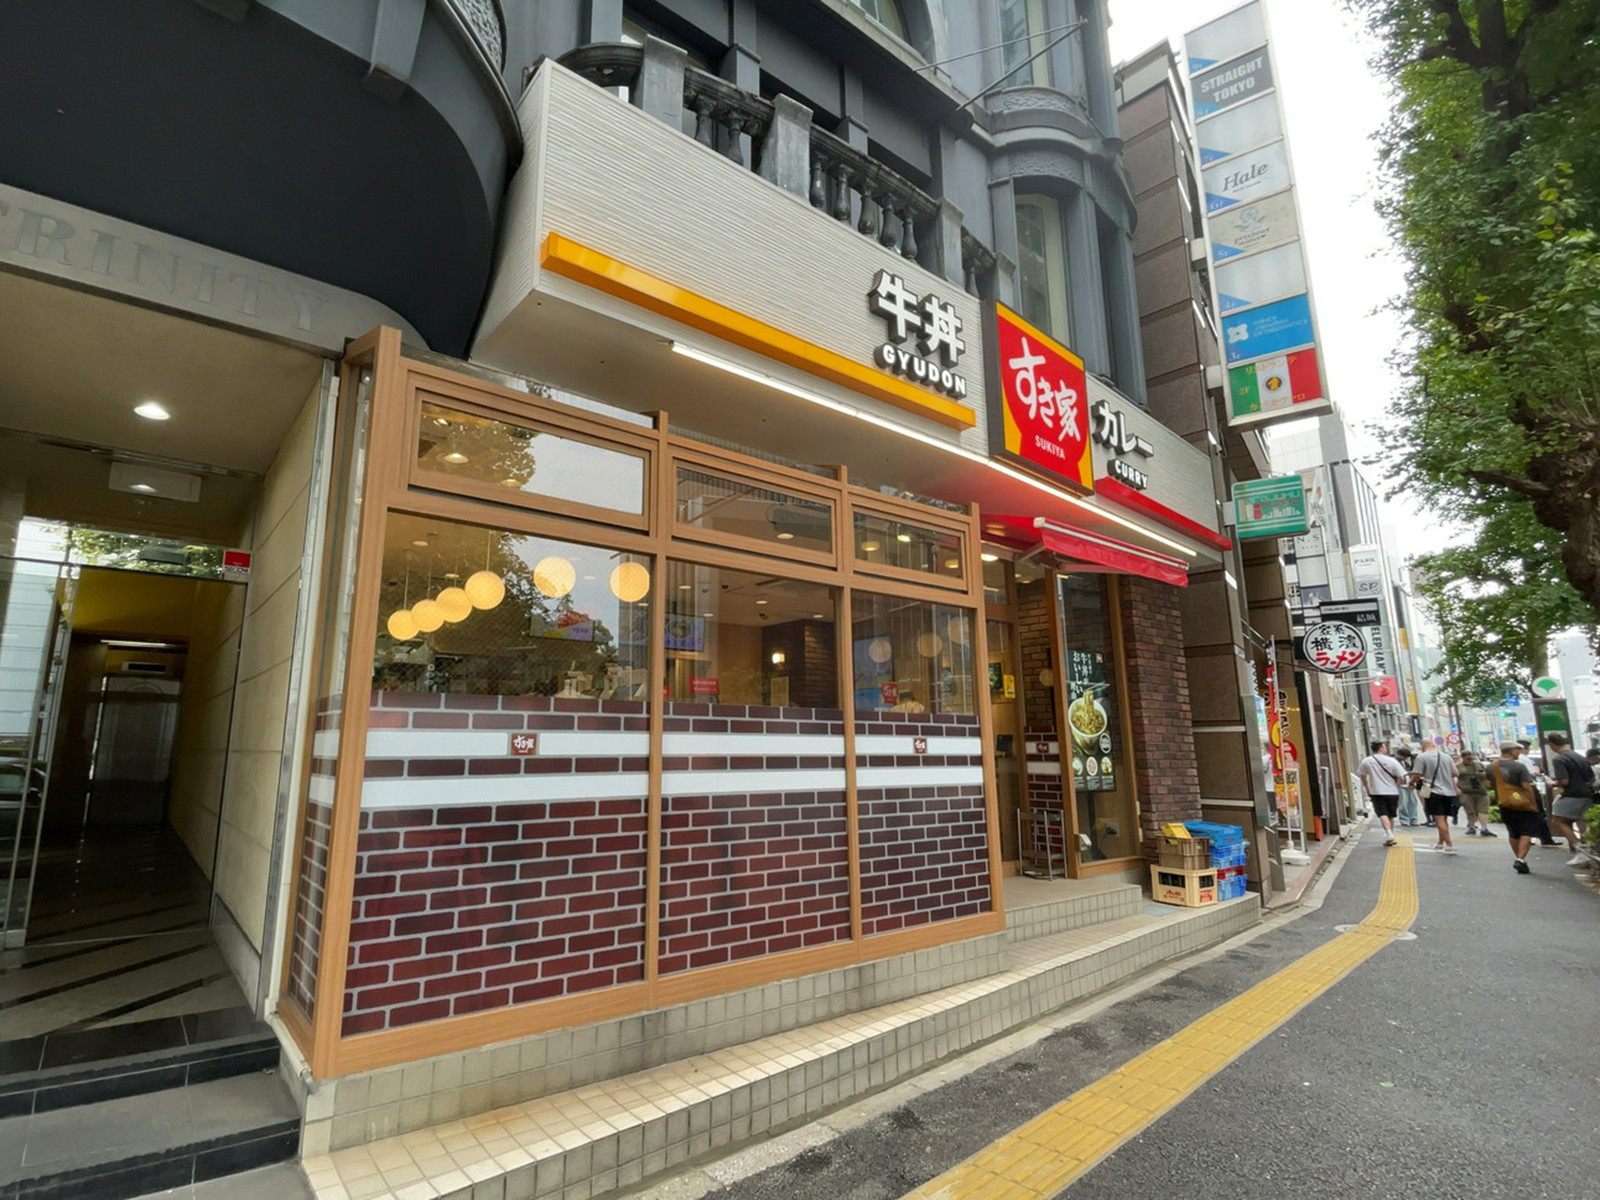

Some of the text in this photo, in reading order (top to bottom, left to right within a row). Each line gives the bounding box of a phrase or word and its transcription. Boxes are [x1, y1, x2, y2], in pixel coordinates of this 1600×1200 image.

[1200, 56, 1264, 93] STRAIGHT
[1212, 77, 1256, 103] TOKYO
[1222, 163, 1269, 193] Hale
[0, 203, 327, 334] RINITY
[874, 270, 965, 364] 牛丼
[881, 344, 967, 398] GYUDON
[1008, 336, 1081, 442] すき家
[1034, 434, 1066, 461] SUKIYA
[1097, 401, 1154, 456] カレー
[1113, 459, 1148, 489] CURRY
[1072, 650, 1084, 695] おいしい
[1314, 650, 1365, 670] ラーメン
